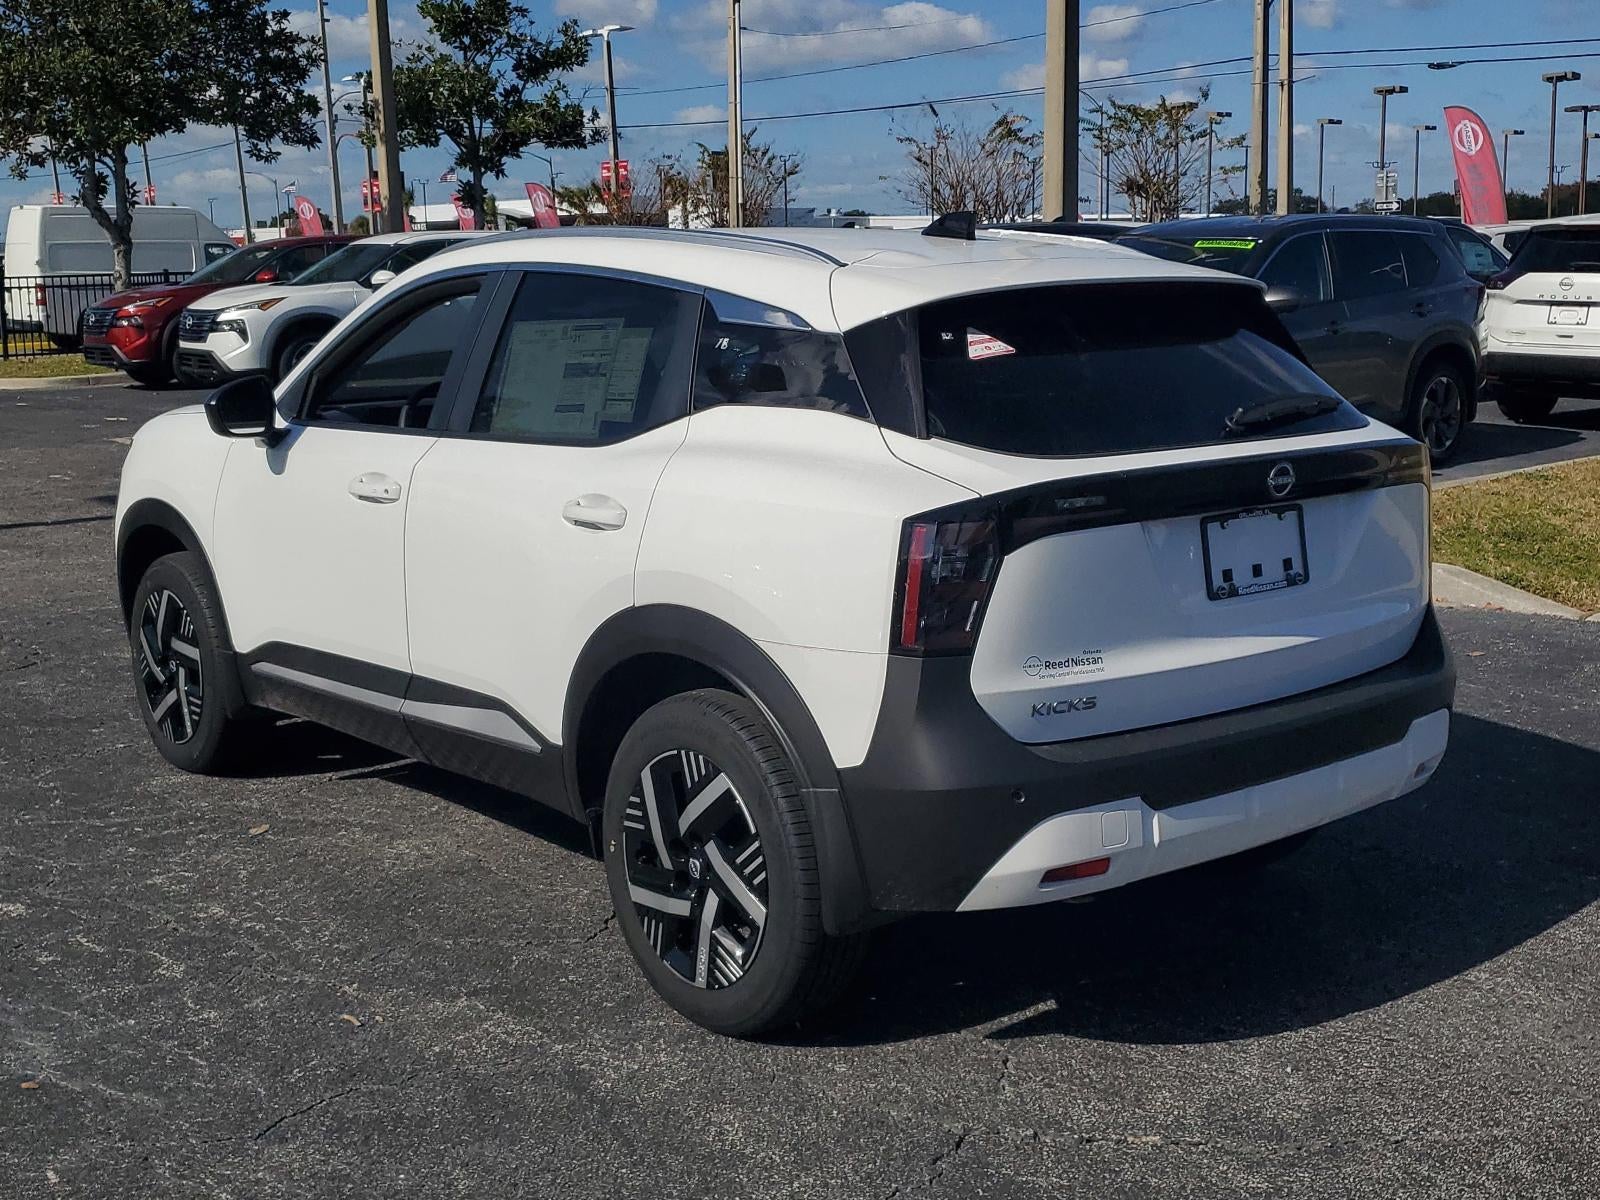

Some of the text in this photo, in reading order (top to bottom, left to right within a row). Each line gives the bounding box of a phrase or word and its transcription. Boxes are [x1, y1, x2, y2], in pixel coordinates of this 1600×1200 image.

[1044, 656, 1104, 670] Reed Nissan
[1031, 696, 1097, 717] KICKS
